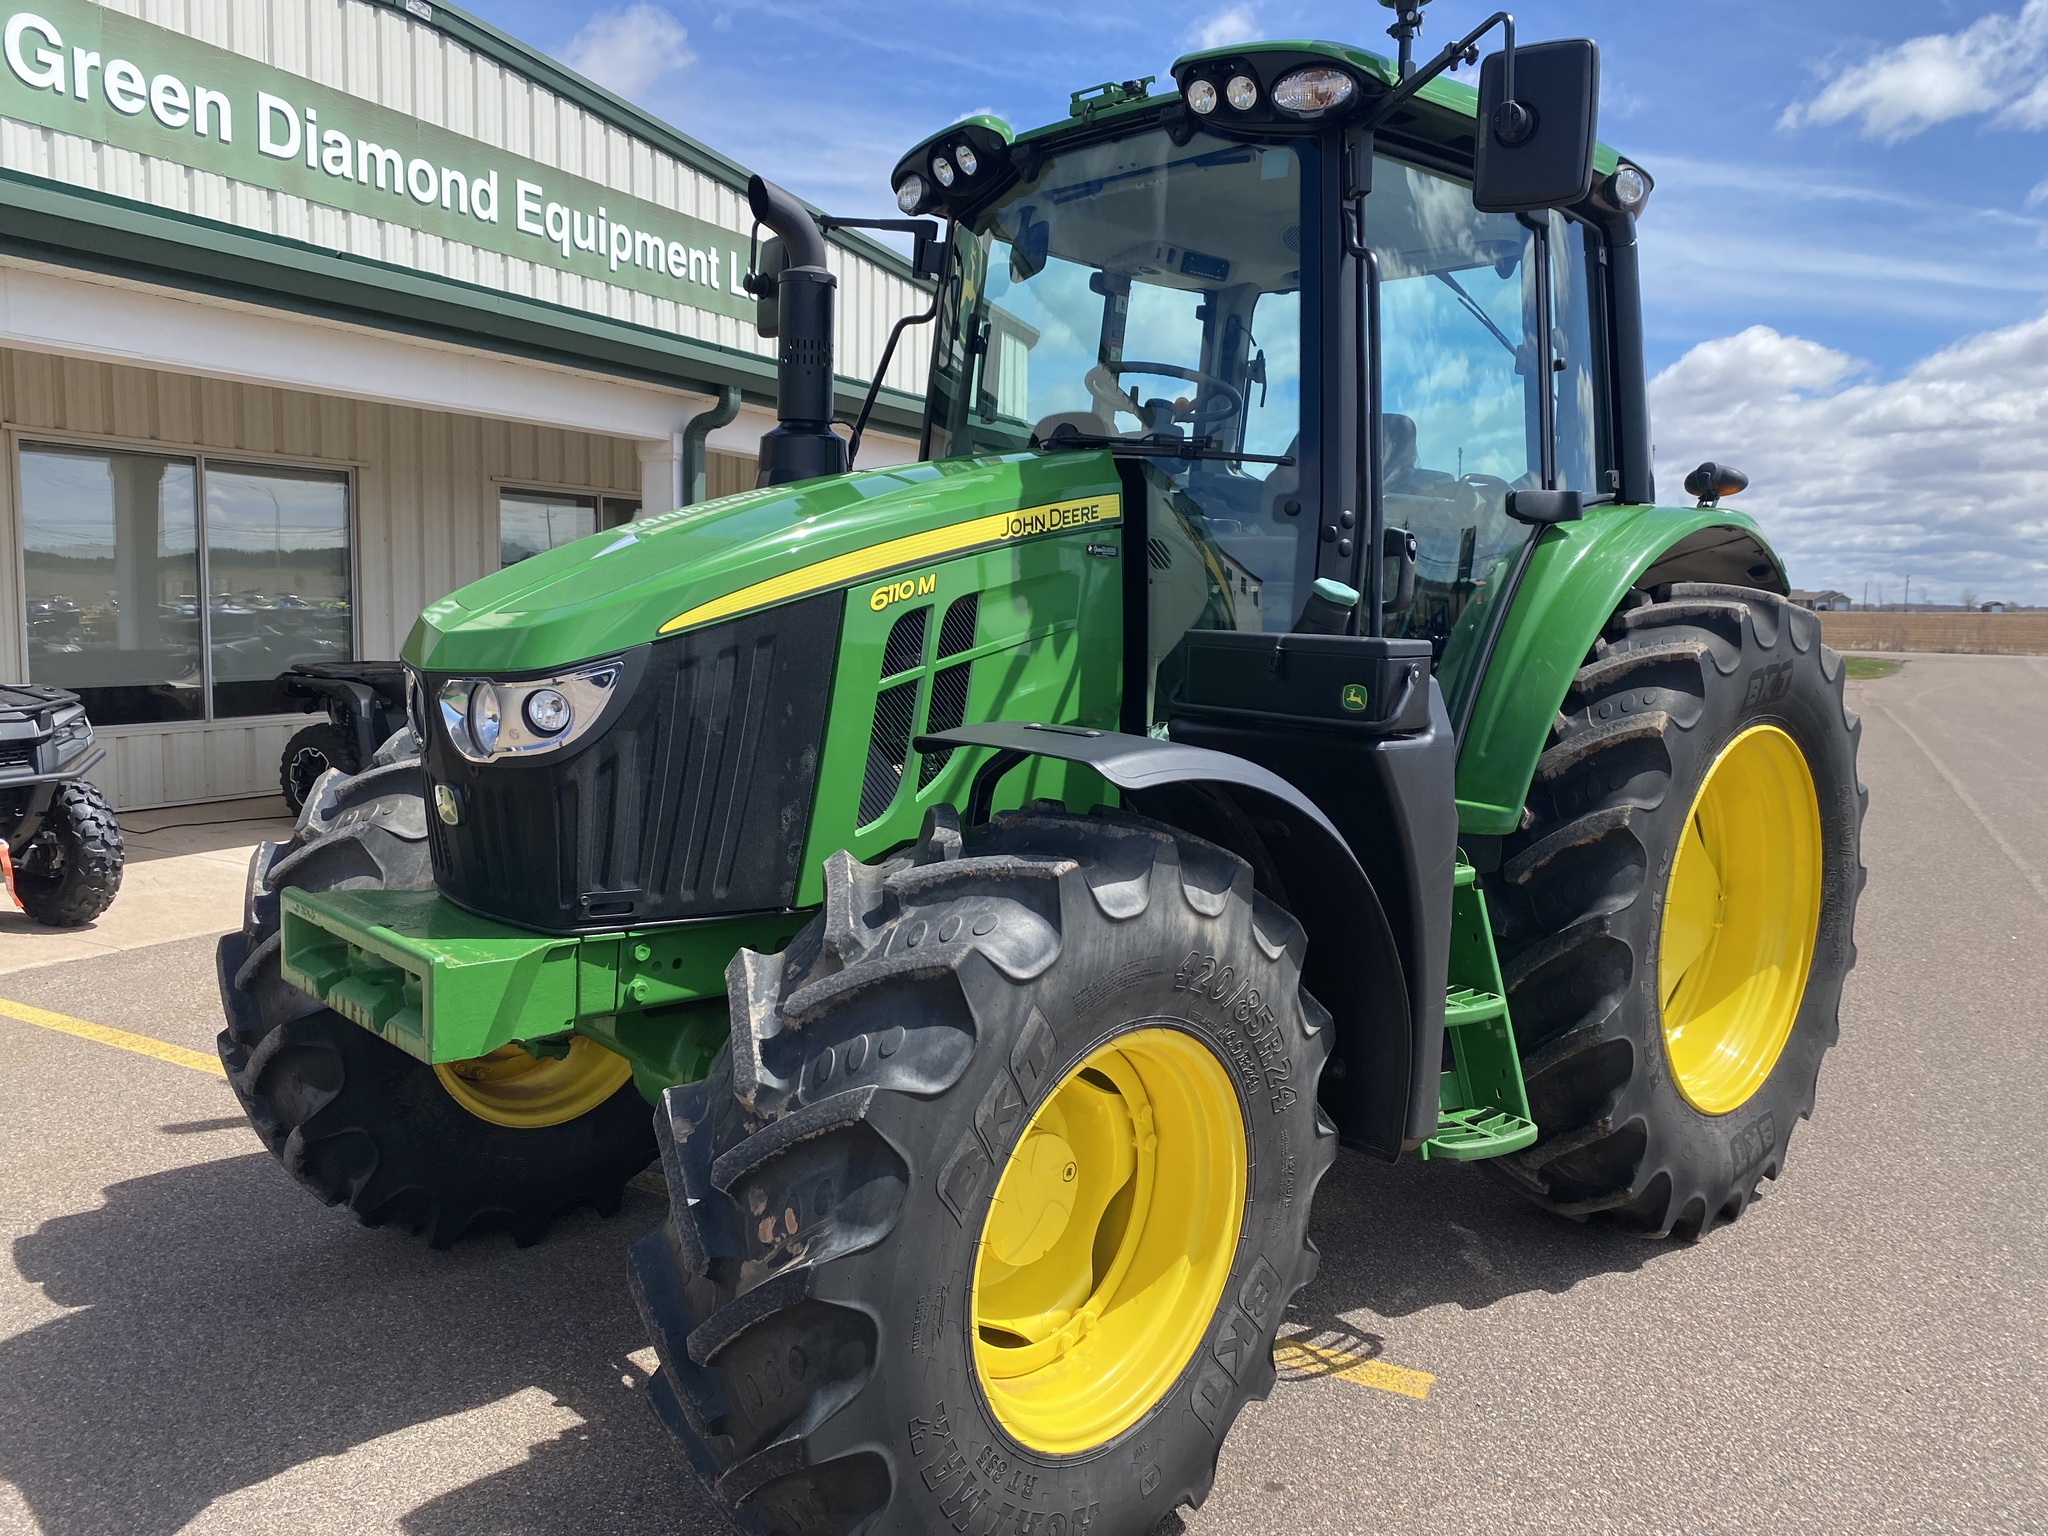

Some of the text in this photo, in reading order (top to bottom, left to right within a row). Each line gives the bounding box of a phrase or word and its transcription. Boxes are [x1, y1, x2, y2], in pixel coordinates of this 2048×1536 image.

[4, 12, 232, 142] Green
[256, 90, 498, 223] Diamond
[516, 178, 719, 272] Equipment
[870, 573, 937, 612] 6110 M
[1000, 504, 1100, 538] JOHN DEERE
[939, 1008, 1054, 1222] BKT
[1173, 949, 1298, 1116] 420/85R24
[1195, 1257, 1282, 1433] BKT
[975, 1443, 1039, 1500] RT 855
